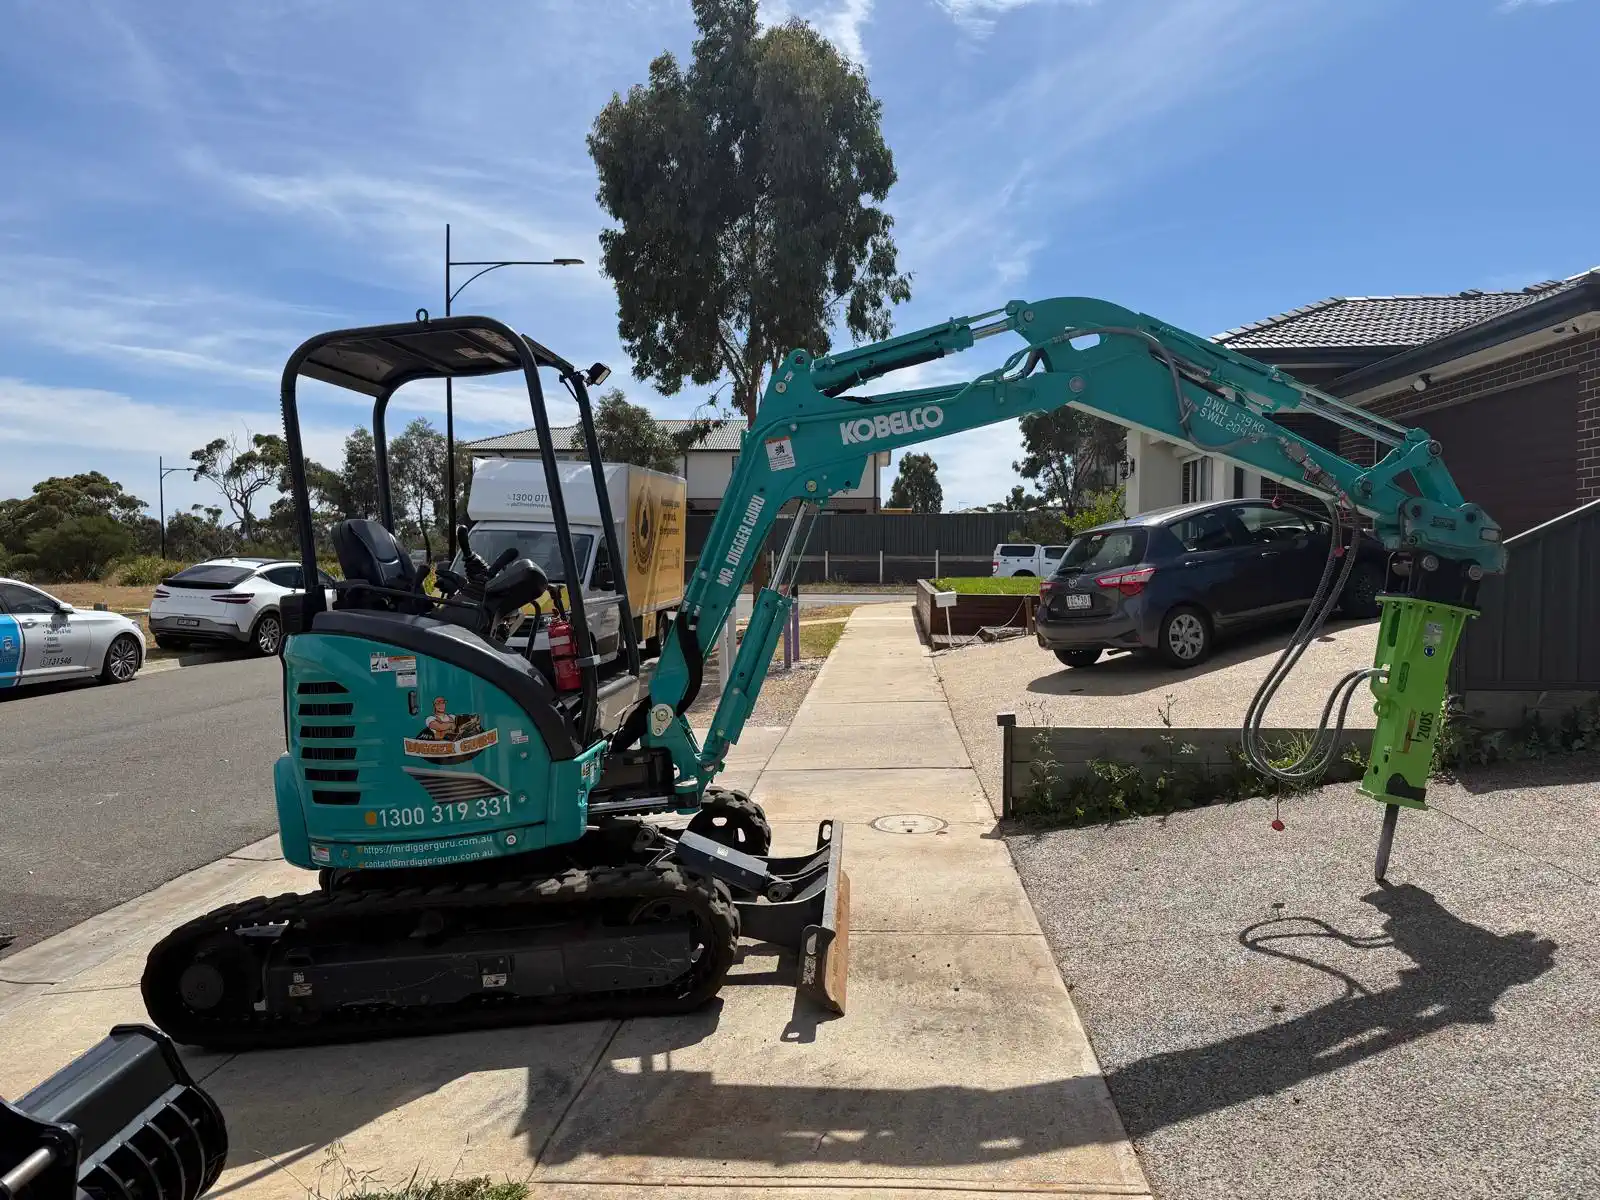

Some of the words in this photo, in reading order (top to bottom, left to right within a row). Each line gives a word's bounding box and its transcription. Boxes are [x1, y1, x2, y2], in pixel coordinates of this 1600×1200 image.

[840, 405, 944, 445] KOBELCO
[743, 494, 766, 527] GURU
[725, 524, 752, 566] DIGGER
[716, 567, 736, 587] MR.
[379, 809, 424, 827] 1300
[431, 802, 468, 823] 319
[476, 795, 511, 817] 331
[363, 835, 493, 855] https://mrdiggerguru.com.au
